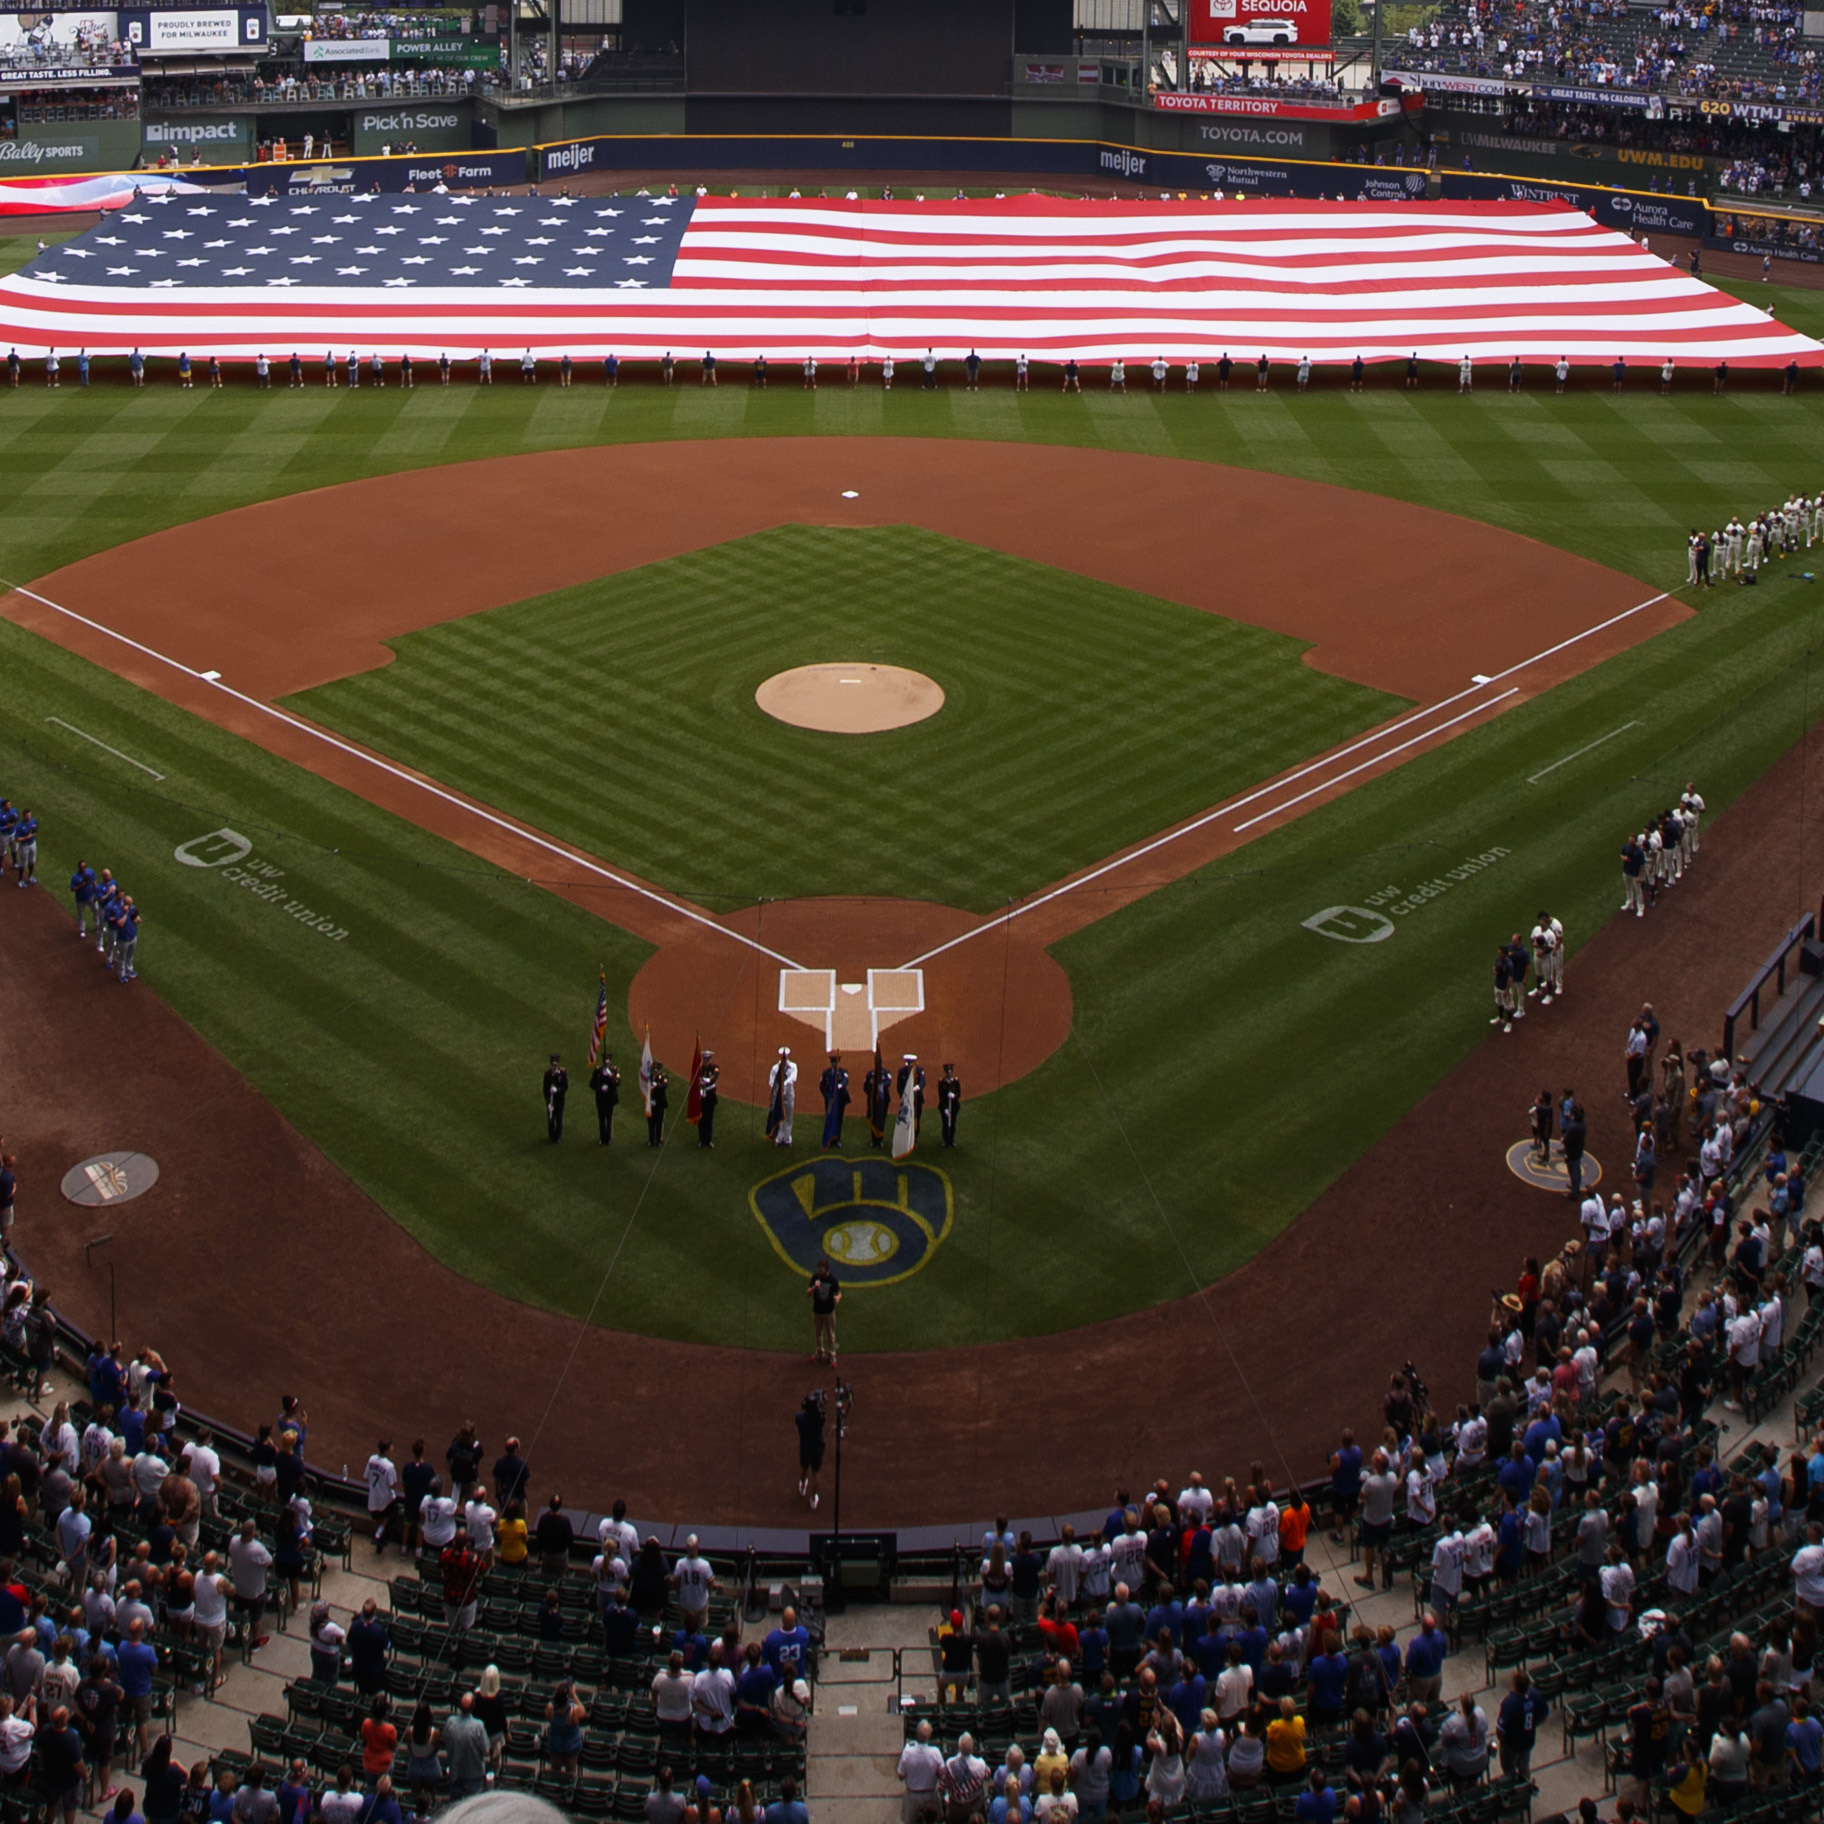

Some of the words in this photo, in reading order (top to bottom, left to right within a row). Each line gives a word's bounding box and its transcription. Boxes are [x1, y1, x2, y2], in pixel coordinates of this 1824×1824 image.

[158, 21, 195, 29] PROUDLY
[197, 20, 231, 28] BREWED
[161, 31, 177, 39] FOR
[179, 29, 228, 38] MILWAUKEE
[396, 43, 430, 53] POWER
[432, 42, 463, 52] ALLEY
[1188, 49, 1218, 57] COURTESY
[1246, 51, 1281, 59] WISCONSIN
[1, 71, 27, 80] GREAT
[29, 70, 56, 79] TASTE.
[57, 69, 77, 78] LESS
[79, 68, 112, 77] FILLING.
[1158, 94, 1205, 108] TOYOTA
[1210, 98, 1278, 113] TERRITORY
[1551, 88, 1575, 99] GREAT
[1599, 93, 1609, 103] 96
[1700, 101, 1731, 117] 620
[1733, 103, 1783, 120] WTMJ
[164, 121, 237, 143] impact
[1200, 126, 1303, 145] TOYOTA.COM
[45, 145, 83, 157] SPORTS
[548, 144, 595, 170] meijer
[1100, 150, 1146, 176] meijer
[1617, 149, 1704, 171] UWM.EDU
[408, 168, 442, 181] Fleet
[458, 165, 492, 178] Farm
[1227, 166, 1287, 179] Northwestern
[1227, 175, 1258, 185] Mutual
[1365, 179, 1400, 191] Johnson
[1371, 188, 1407, 200] Controls
[1634, 202, 1668, 216] Aurora
[1632, 213, 1666, 226] Health
[1669, 216, 1694, 230] Care
[246, 858, 285, 878] uw
[1390, 877, 1454, 915] credit
[1446, 846, 1511, 881] union
[1364, 884, 1401, 907] uw
[221, 867, 288, 902] credit
[283, 900, 349, 941] union
[779, 1643, 802, 1663] 23
